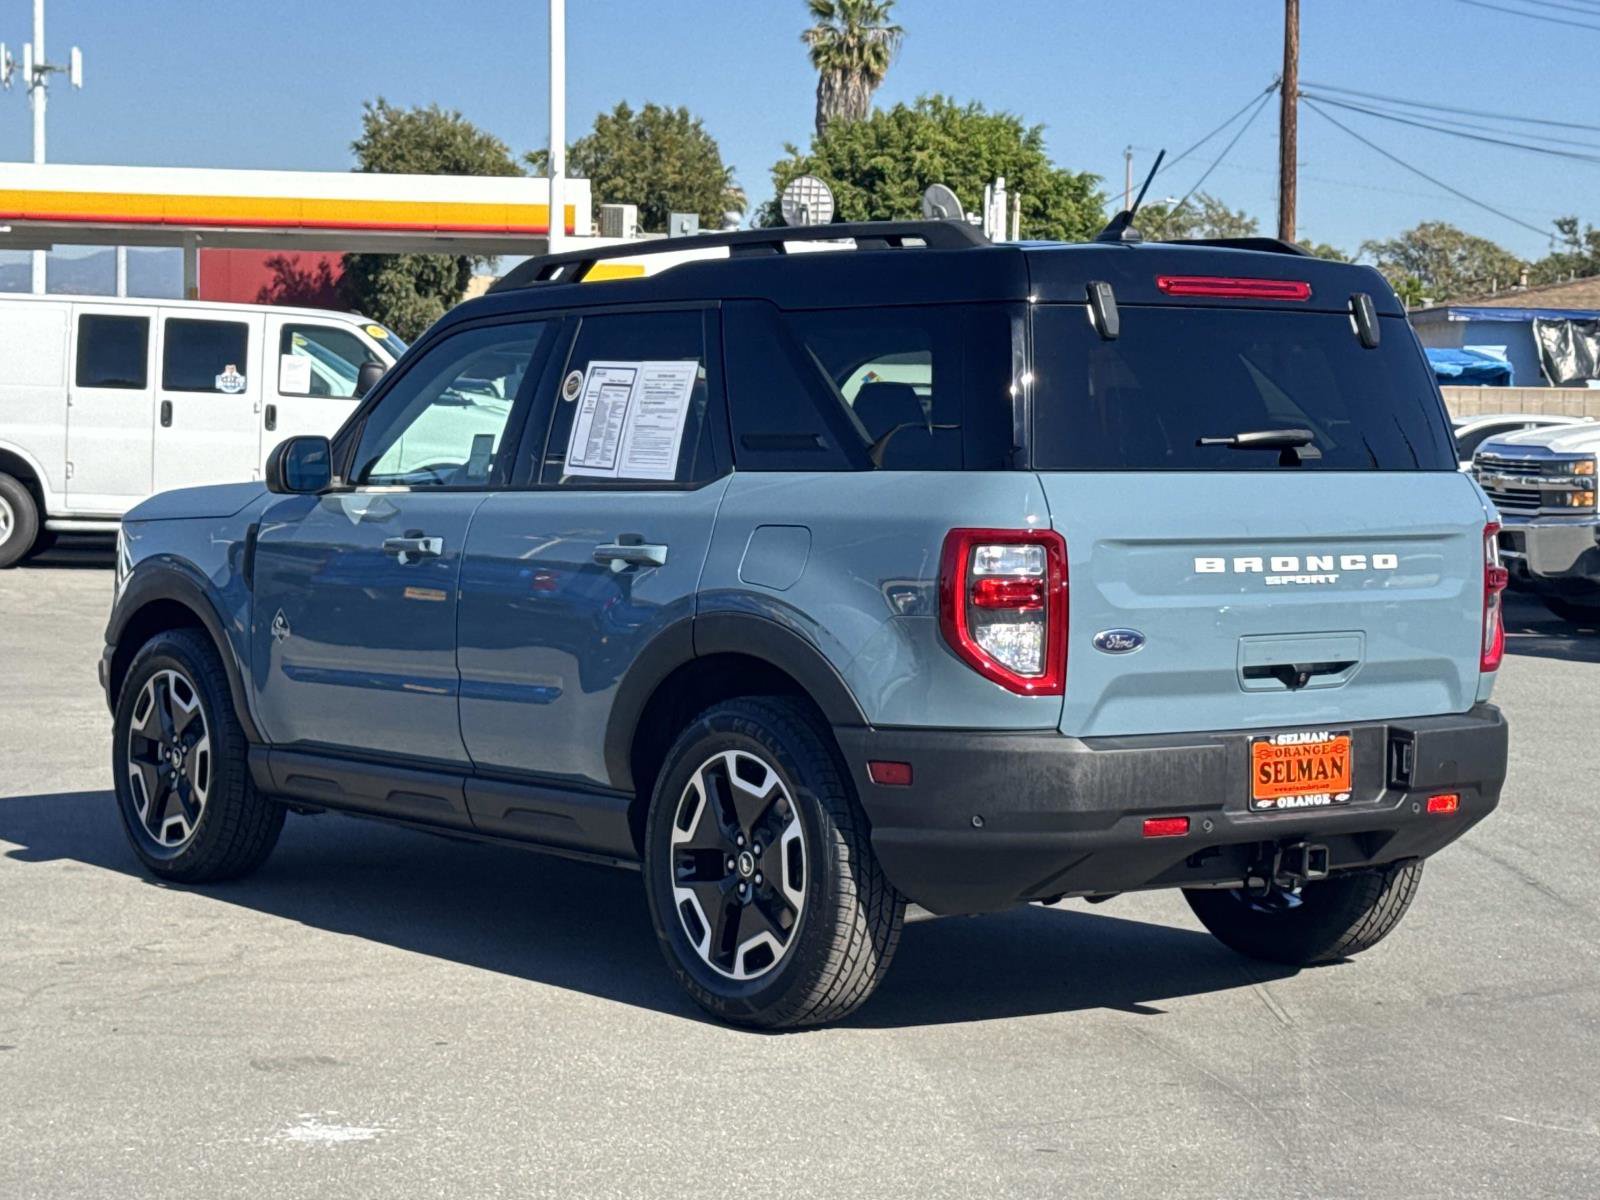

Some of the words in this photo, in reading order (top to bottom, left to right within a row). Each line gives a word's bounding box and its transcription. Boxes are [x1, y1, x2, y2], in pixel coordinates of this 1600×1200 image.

[1194, 554, 1398, 573] BRONCO
[1264, 574, 1340, 585] SPORT
[1106, 634, 1135, 649] Ford
[732, 718, 788, 757] KELLY
[1276, 731, 1329, 745] SELMAN
[1274, 744, 1330, 758] ORANGE
[1259, 755, 1344, 784] SELMAN
[1276, 793, 1331, 809] ORANGE
